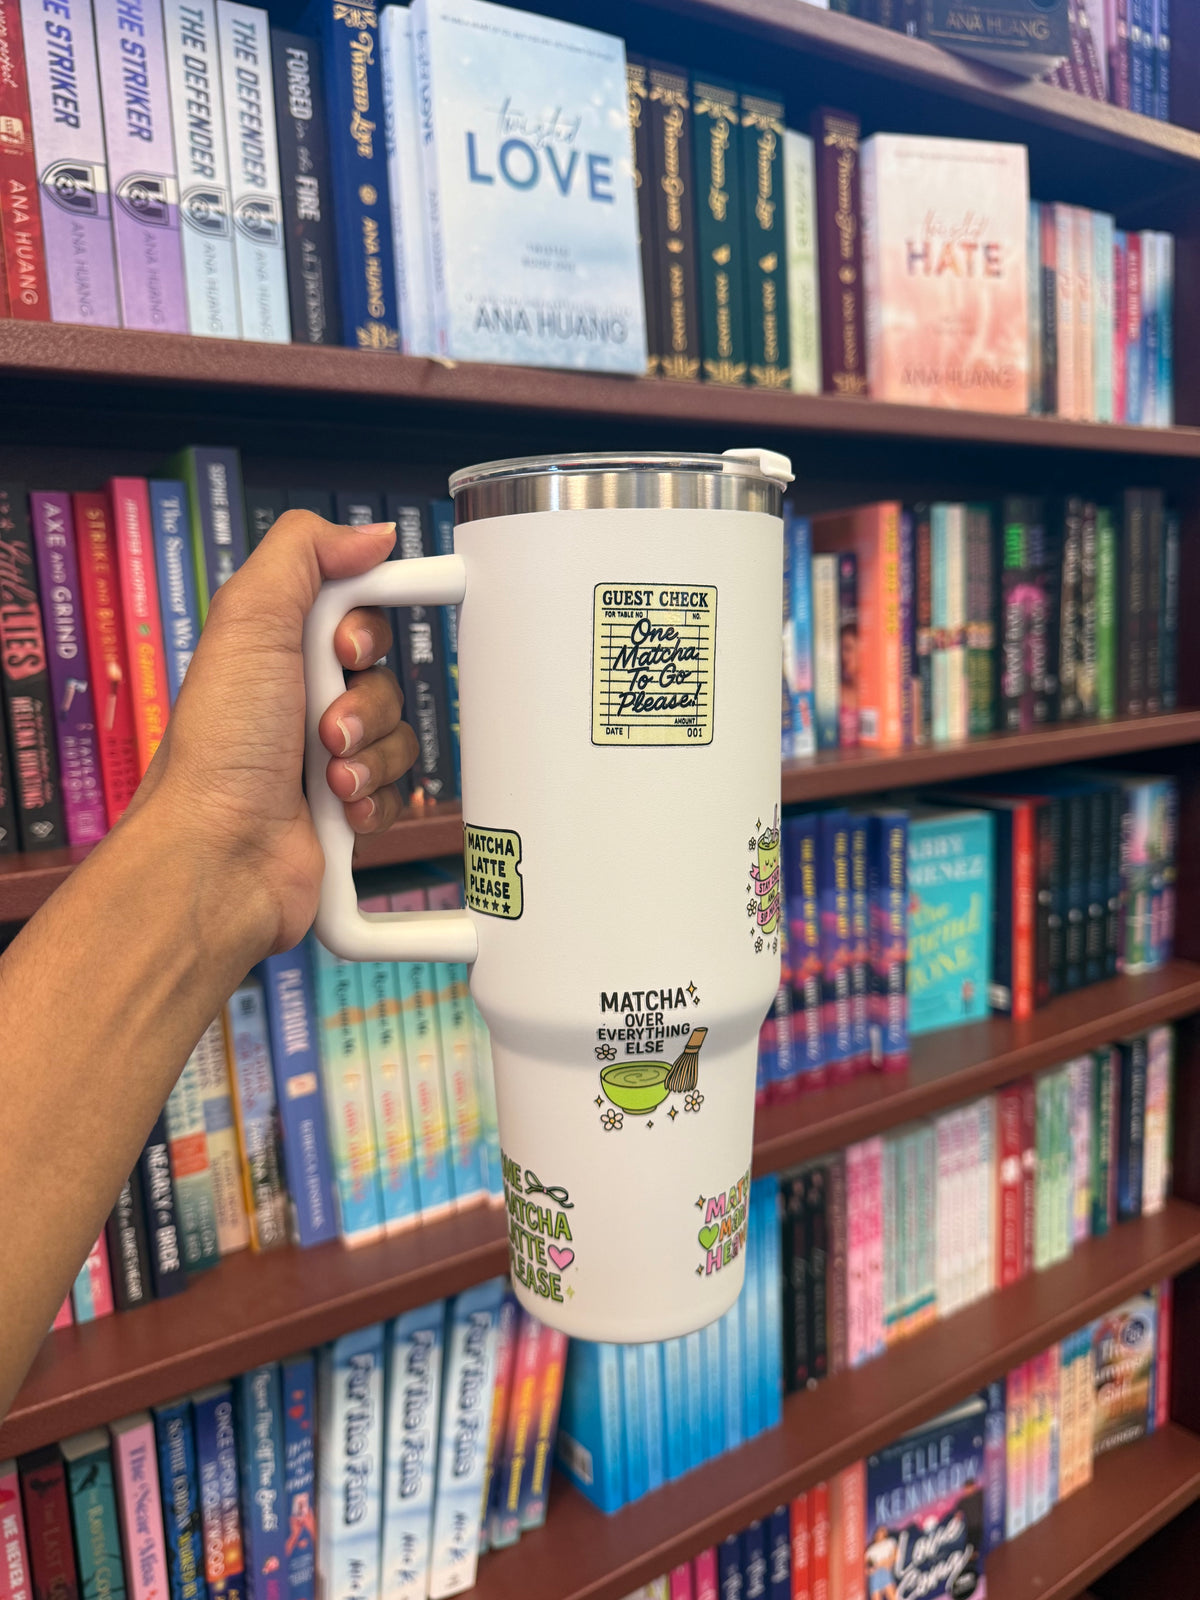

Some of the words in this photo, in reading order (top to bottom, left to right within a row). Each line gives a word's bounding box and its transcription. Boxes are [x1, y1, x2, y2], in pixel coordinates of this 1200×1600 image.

[180, 5, 206, 53] THE
[232, 18, 259, 66] THE
[45, 20, 81, 130] STRIKER
[120, 38, 153, 143] STRIKER
[286, 47, 313, 121] FORGED
[183, 54, 215, 180] DEFENDER
[236, 67, 267, 189] DEFENDER
[465, 130, 616, 205] LOVE
[9, 179, 31, 225] ANA
[295, 175, 321, 222] FIRE
[71, 221, 87, 255] ANA
[143, 231, 158, 265] ANA
[361, 216, 380, 255] ANA
[15, 231, 39, 306] HUANG
[906, 242, 1004, 279] HATE
[75, 259, 94, 318] HUANG
[148, 268, 165, 325] HUANG
[365, 256, 386, 319] HUANG
[473, 304, 534, 337] ANA
[535, 307, 629, 347] HUANG
[42, 501, 67, 549] AXE
[160, 496, 182, 534] The
[398, 506, 425, 558] FORGE
[87, 508, 111, 574] STRIKE
[164, 535, 187, 617] Summer
[602, 590, 654, 606] GUEST
[659, 591, 709, 608] CHECK
[3, 612, 41, 667] LIES
[52, 586, 79, 660] GRIND
[172, 618, 193, 650] We
[408, 622, 434, 665] FIRE
[631, 618, 679, 645] One
[613, 640, 700, 670] Matcha
[628, 666, 653, 691] To
[659, 663, 692, 688] Go
[617, 683, 702, 717] Please!
[605, 727, 623, 735] DATE
[687, 728, 703, 737] 001
[468, 831, 515, 857] MATCHA
[471, 854, 506, 878] LATTE
[470, 874, 511, 900] PLEASE
[759, 880, 770, 893] STAY
[760, 911, 768, 923] SIP
[278, 968, 310, 1056] PLAYBOOK
[600, 987, 687, 1012] MATCHA
[625, 1012, 664, 1028] OVER
[598, 1023, 690, 1041] EVERYTHING
[626, 1040, 664, 1055] ELSE
[147, 1144, 173, 1210] NEARLY
[502, 1154, 523, 1193] NE
[154, 1224, 180, 1275] BRIDE
[510, 1216, 547, 1266] ATTE
[512, 1250, 564, 1303] LEASE
[407, 1330, 435, 1376] For
[466, 1312, 491, 1356] For
[347, 1353, 375, 1401] For
[460, 1361, 488, 1417] the
[215, 1401, 235, 1449] ONCE
[345, 1402, 372, 1454] the
[404, 1378, 432, 1430] the
[127, 1444, 147, 1482] The
[167, 1418, 186, 1474] SOPHIE
[400, 1432, 429, 1500] Fans
[454, 1418, 480, 1478] Fans
[902, 1434, 954, 1483] ELLE
[201, 1462, 218, 1481] IN
[218, 1450, 237, 1496] UPON
[343, 1455, 371, 1527] Fans
[875, 1454, 980, 1523] KENNEDY
[172, 1474, 192, 1530] JORDAN
[2, 1513, 19, 1540] WE
[202, 1481, 225, 1577] DOLLYWOOD
[222, 1509, 241, 1545] TIME
[5, 1540, 24, 1590] NEVER
